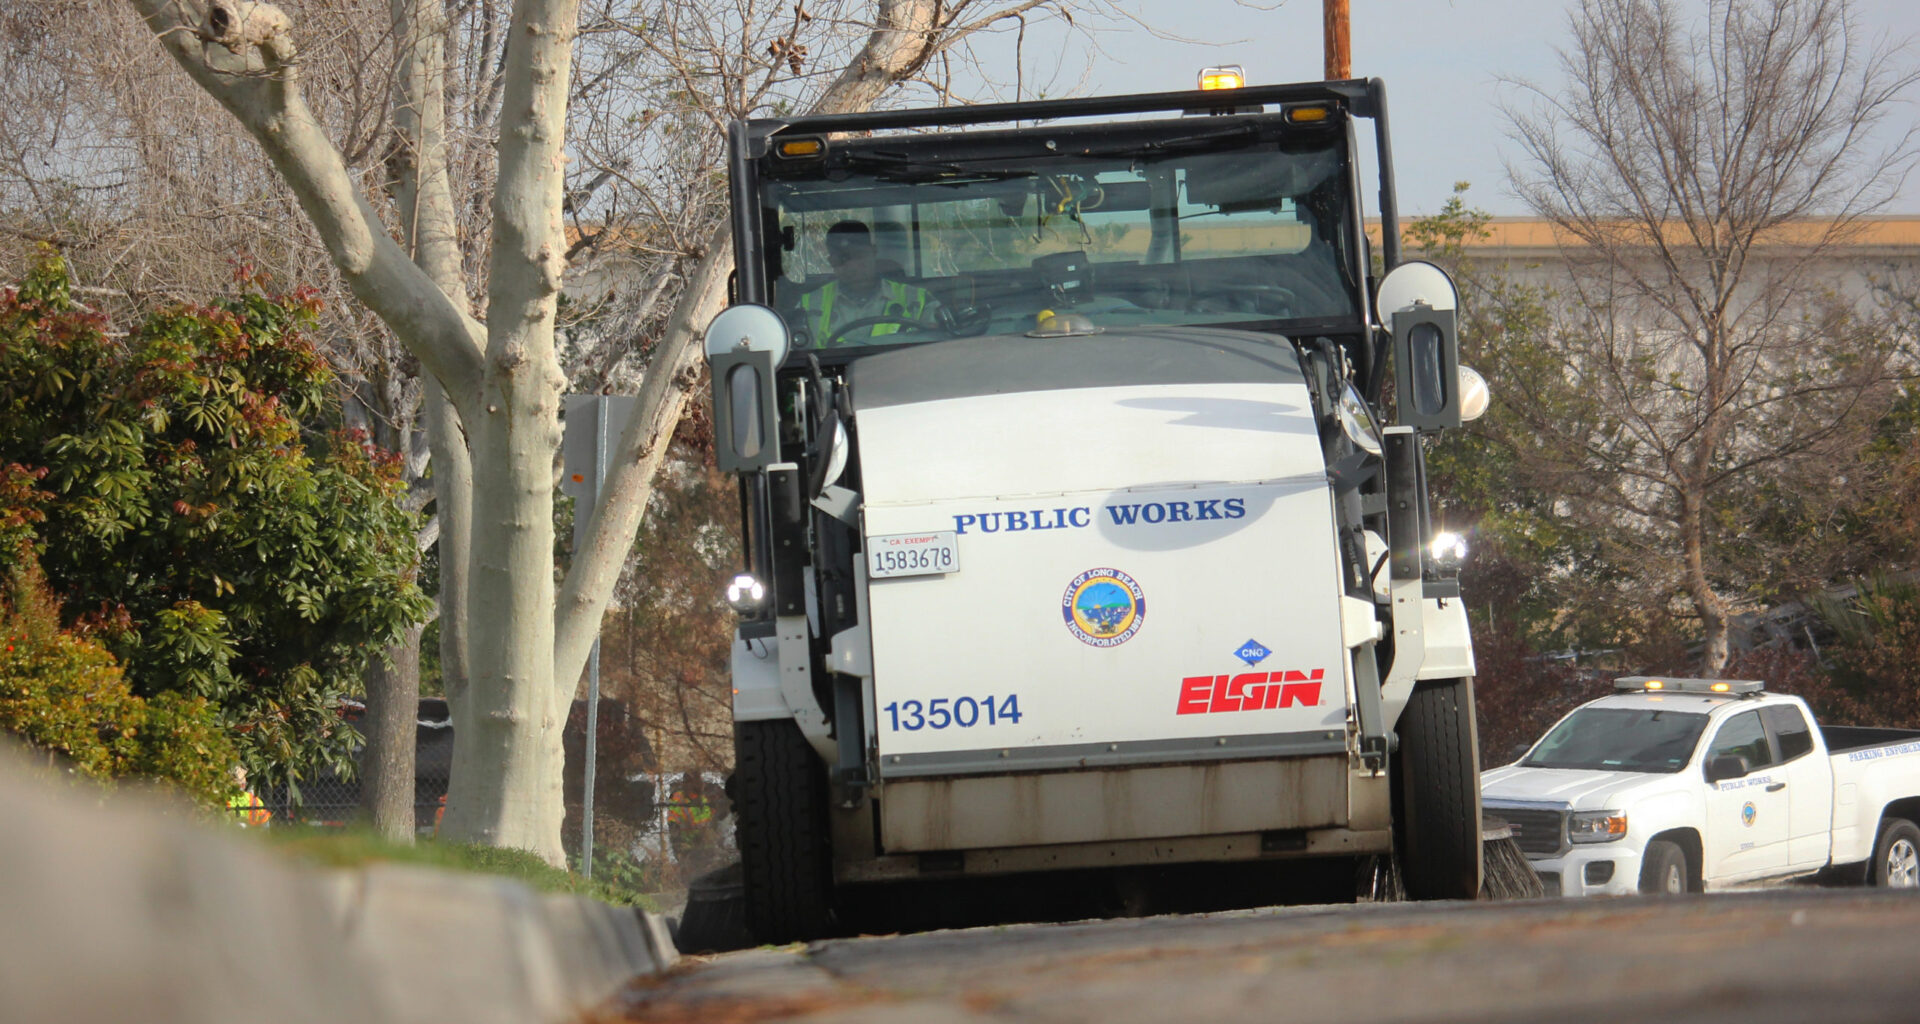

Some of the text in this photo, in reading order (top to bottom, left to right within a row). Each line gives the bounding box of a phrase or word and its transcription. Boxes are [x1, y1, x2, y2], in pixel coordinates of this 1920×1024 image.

[952, 498, 1246, 535] PUBLIC WORKS
[904, 536, 935, 545] EXEMPT
[875, 547, 952, 572] 1583678
[1063, 569, 1143, 608] CITY OF LONG BEACH
[1067, 620, 1132, 647] INCORPORATED
[1241, 648, 1264, 658] CNG
[1176, 668, 1325, 716] ELGIN
[883, 694, 1023, 732] 135014
[1848, 748, 1883, 762] PARKING
[1720, 776, 1771, 792] PUBLIC WORKS
